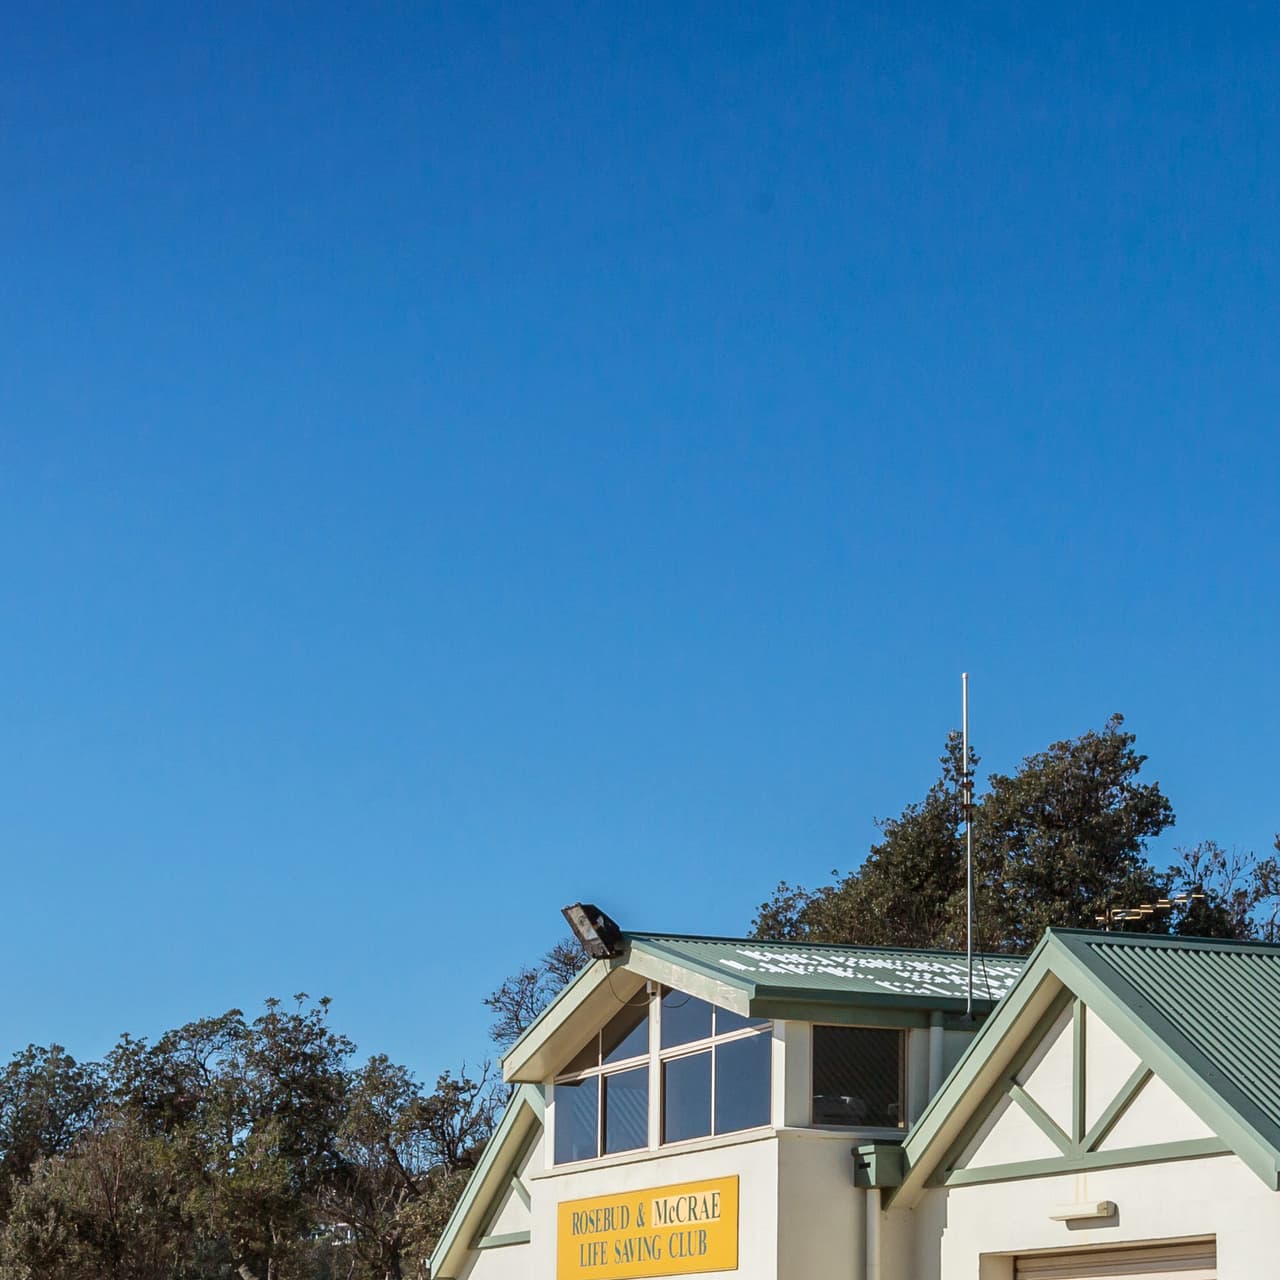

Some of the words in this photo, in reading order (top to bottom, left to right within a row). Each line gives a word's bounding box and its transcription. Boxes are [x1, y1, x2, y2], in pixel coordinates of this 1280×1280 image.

[572, 1205, 630, 1236] ROSEBUD
[636, 1202, 645, 1228] &
[654, 1192, 721, 1226] McCRAE
[579, 1240, 609, 1268] LIFE
[614, 1234, 662, 1265] SAVING
[669, 1229, 708, 1259] CLUB
